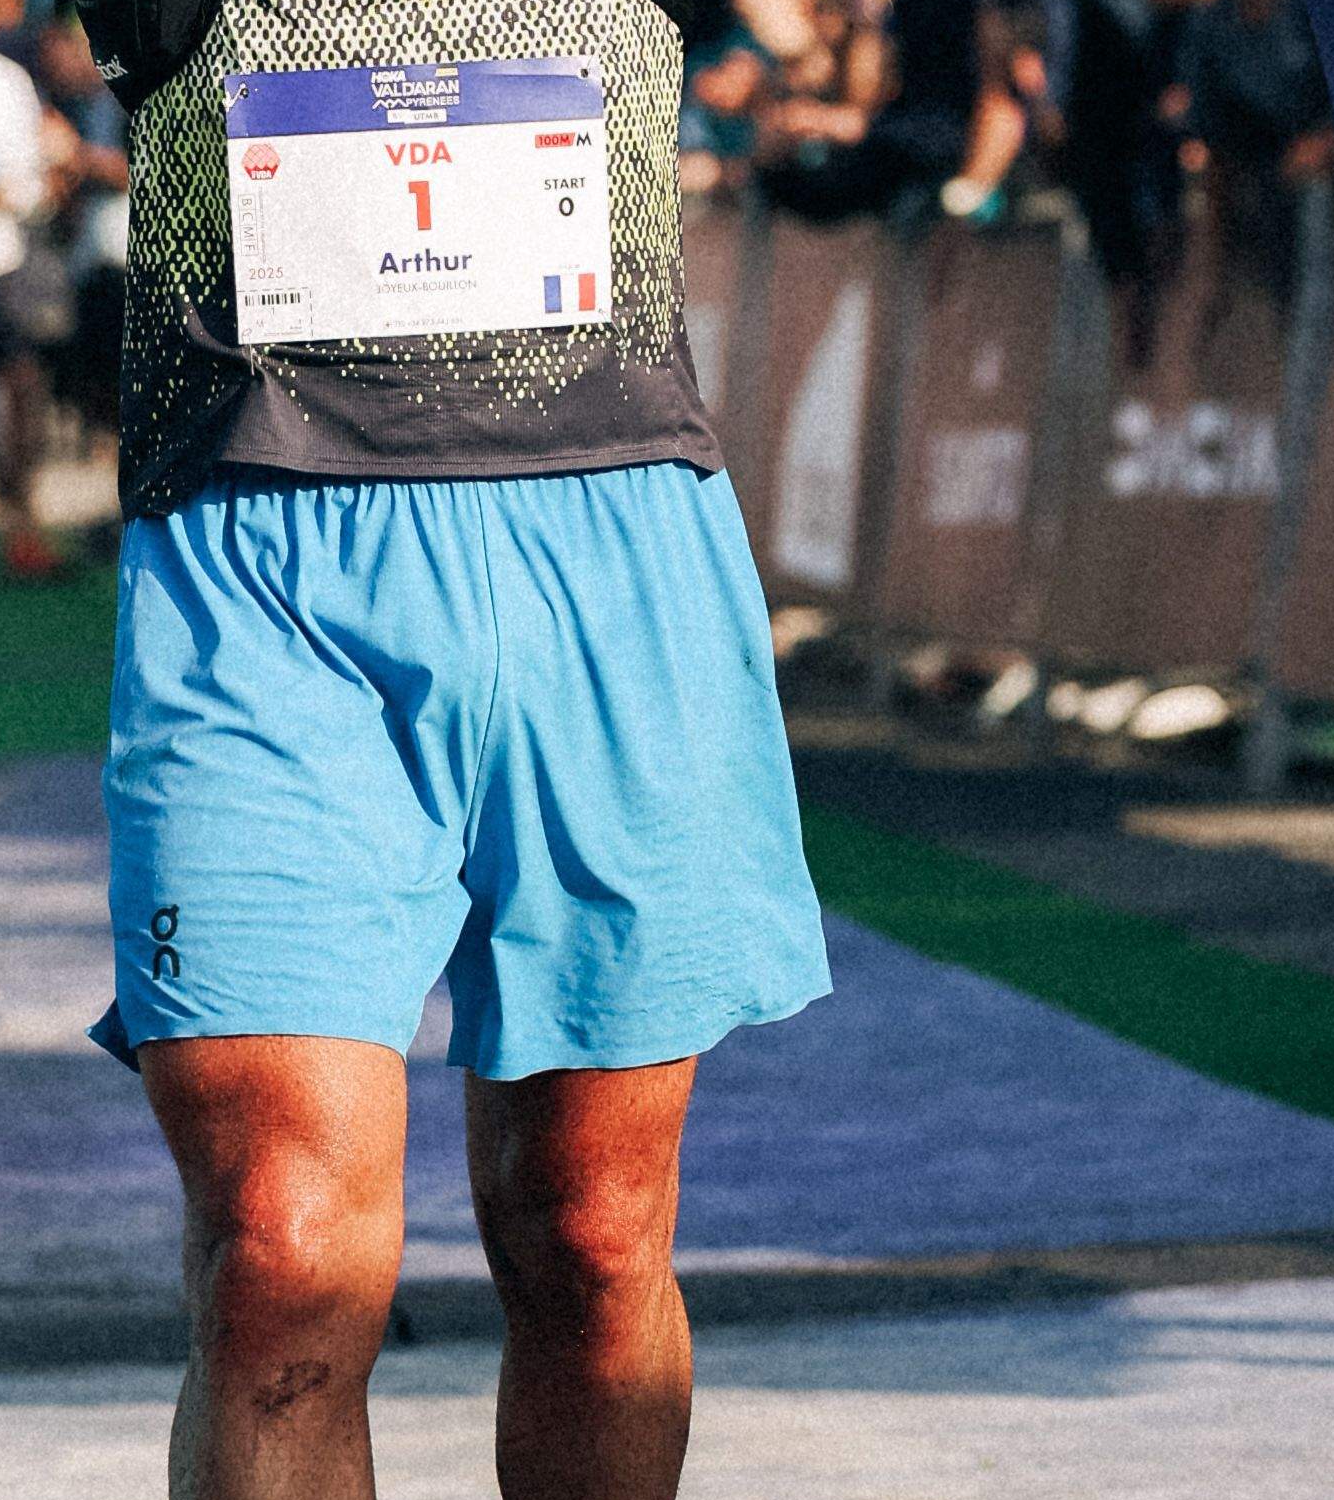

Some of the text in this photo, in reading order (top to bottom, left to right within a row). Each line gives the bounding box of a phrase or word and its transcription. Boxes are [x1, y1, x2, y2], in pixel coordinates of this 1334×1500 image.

[371, 70, 406, 84] HOKA
[406, 96, 460, 107] PYRENEES
[538, 134, 571, 147] 100M
[384, 140, 453, 167] VDA
[544, 177, 587, 191] START
[408, 180, 432, 231] 1
[559, 196, 575, 217] 0
[379, 248, 473, 275] Arthur
[249, 266, 284, 280] 2025
